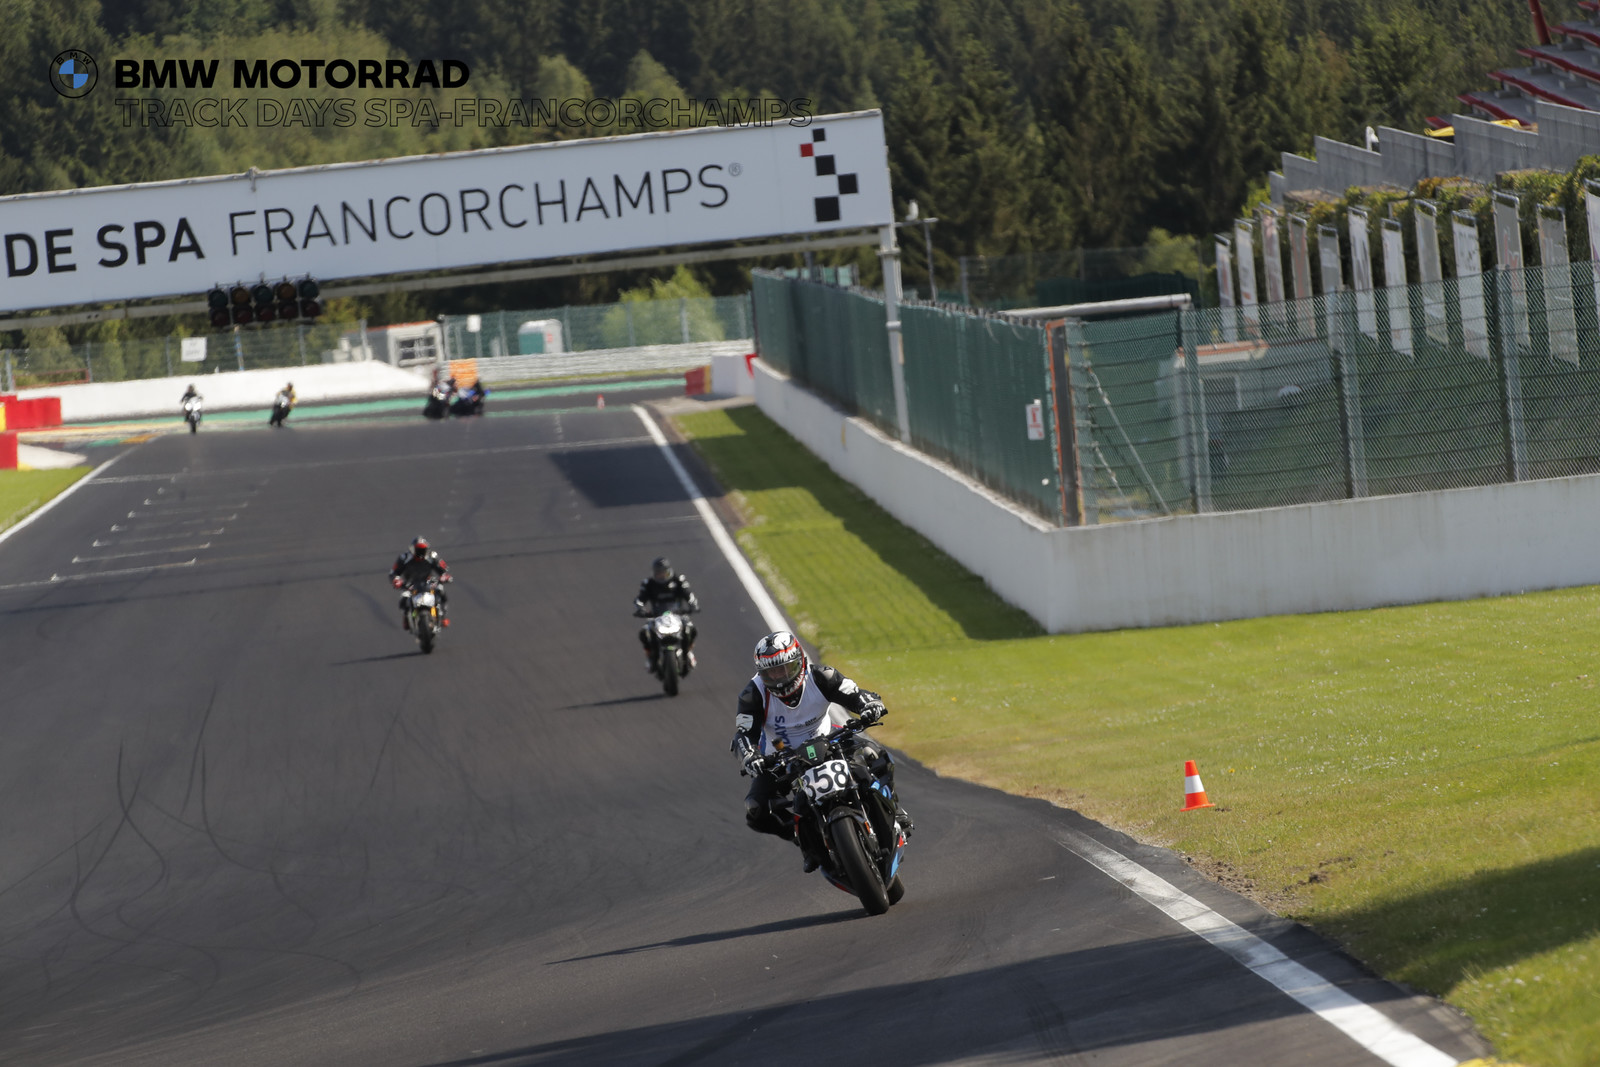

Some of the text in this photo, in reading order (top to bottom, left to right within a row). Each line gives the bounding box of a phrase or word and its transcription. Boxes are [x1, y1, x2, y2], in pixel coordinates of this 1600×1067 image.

[4, 228, 77, 278] DE
[96, 217, 205, 268] SPA
[803, 761, 848, 801] 358
